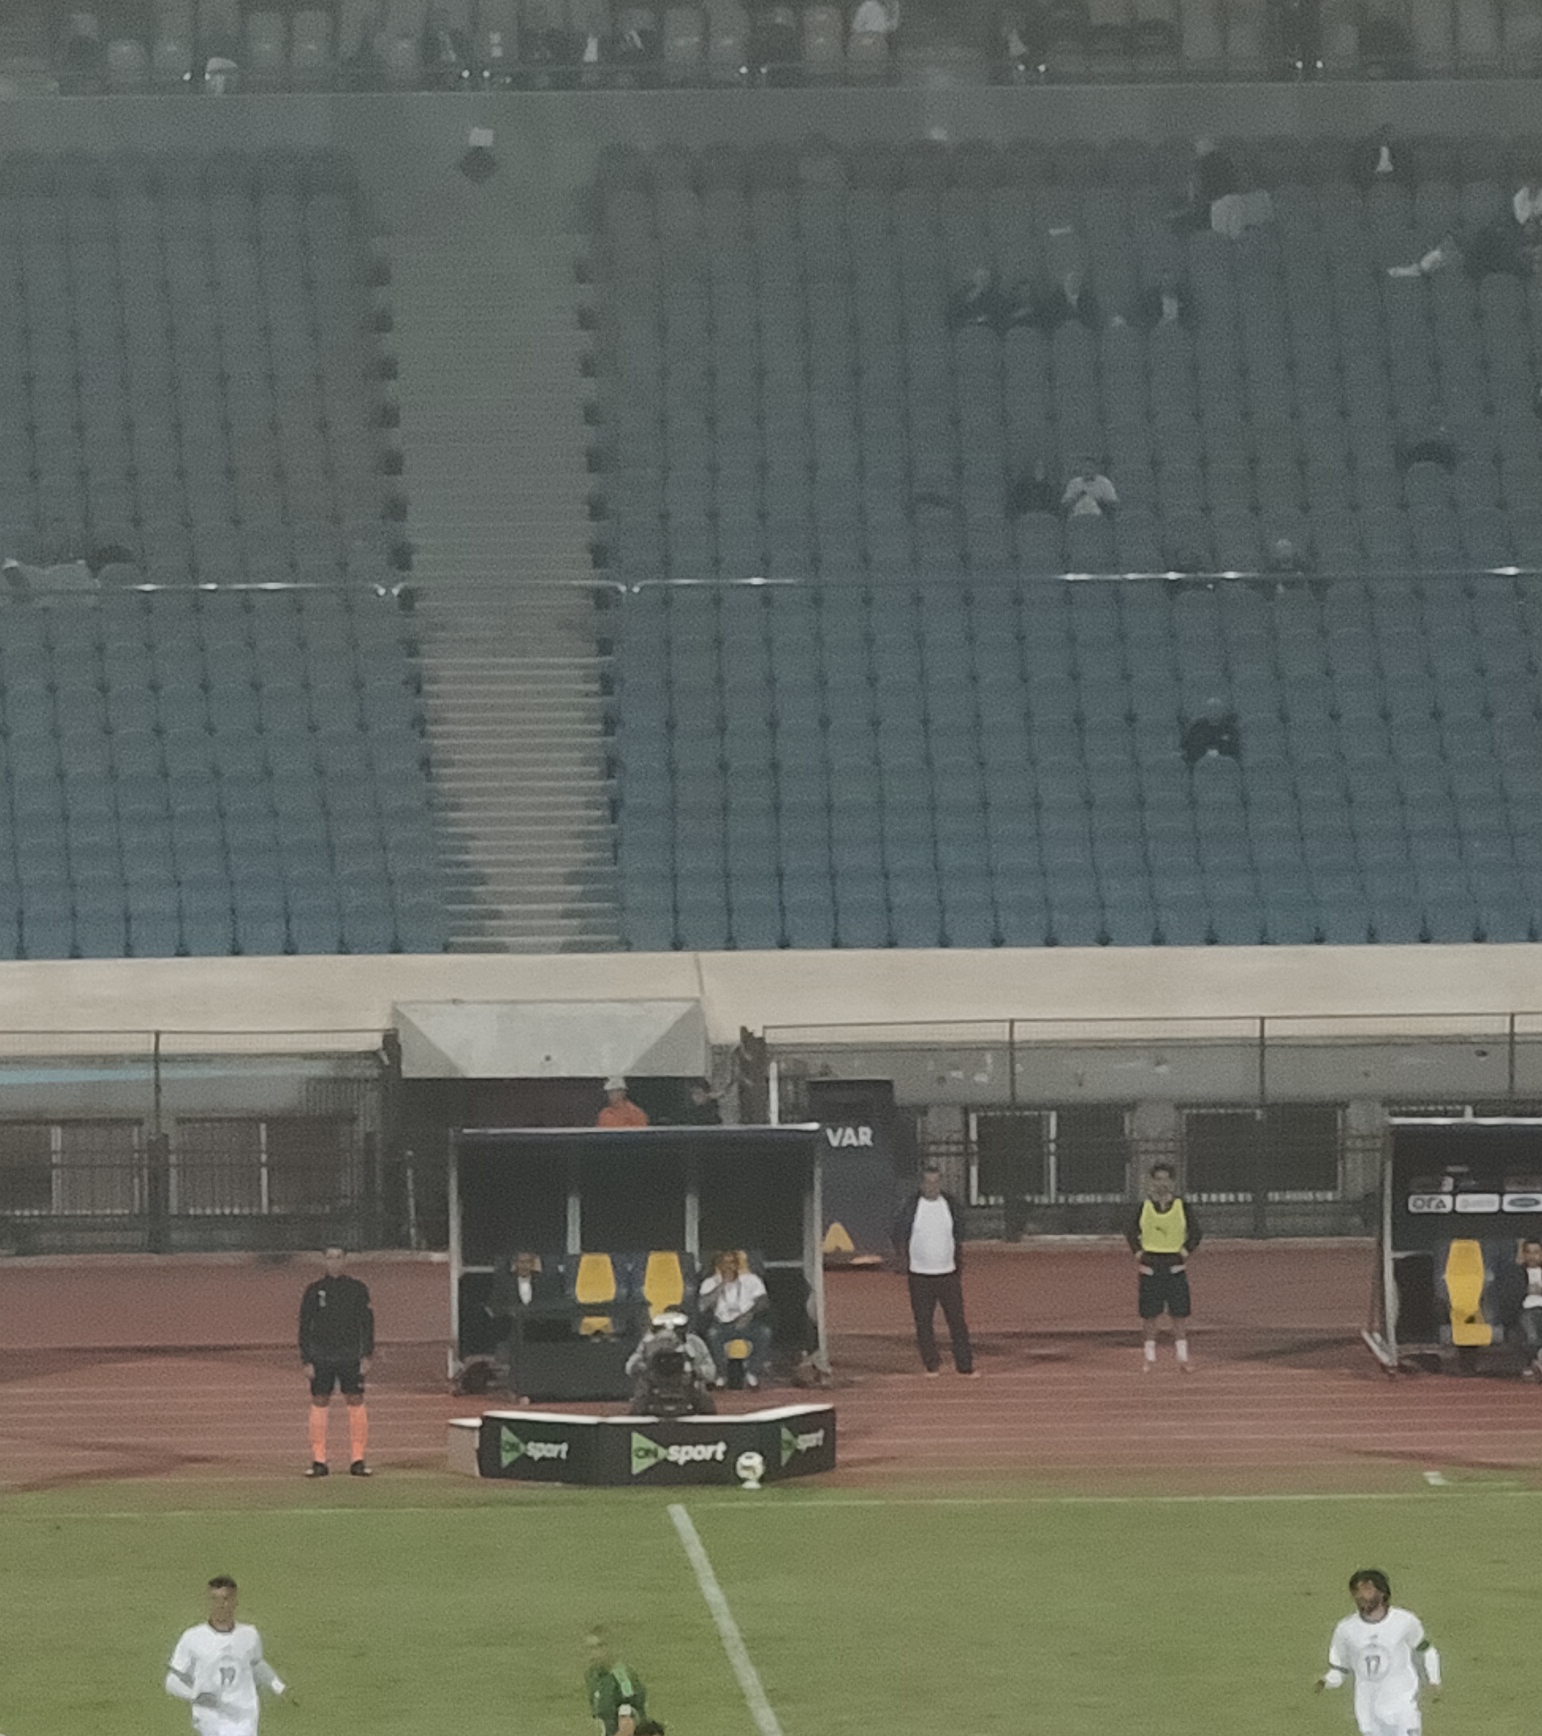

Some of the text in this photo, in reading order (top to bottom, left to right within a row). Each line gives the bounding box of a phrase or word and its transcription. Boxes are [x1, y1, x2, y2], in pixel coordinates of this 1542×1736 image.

[826, 1126, 874, 1147] VAR
[526, 1441, 569, 1461] sport
[666, 1441, 727, 1466] sport
